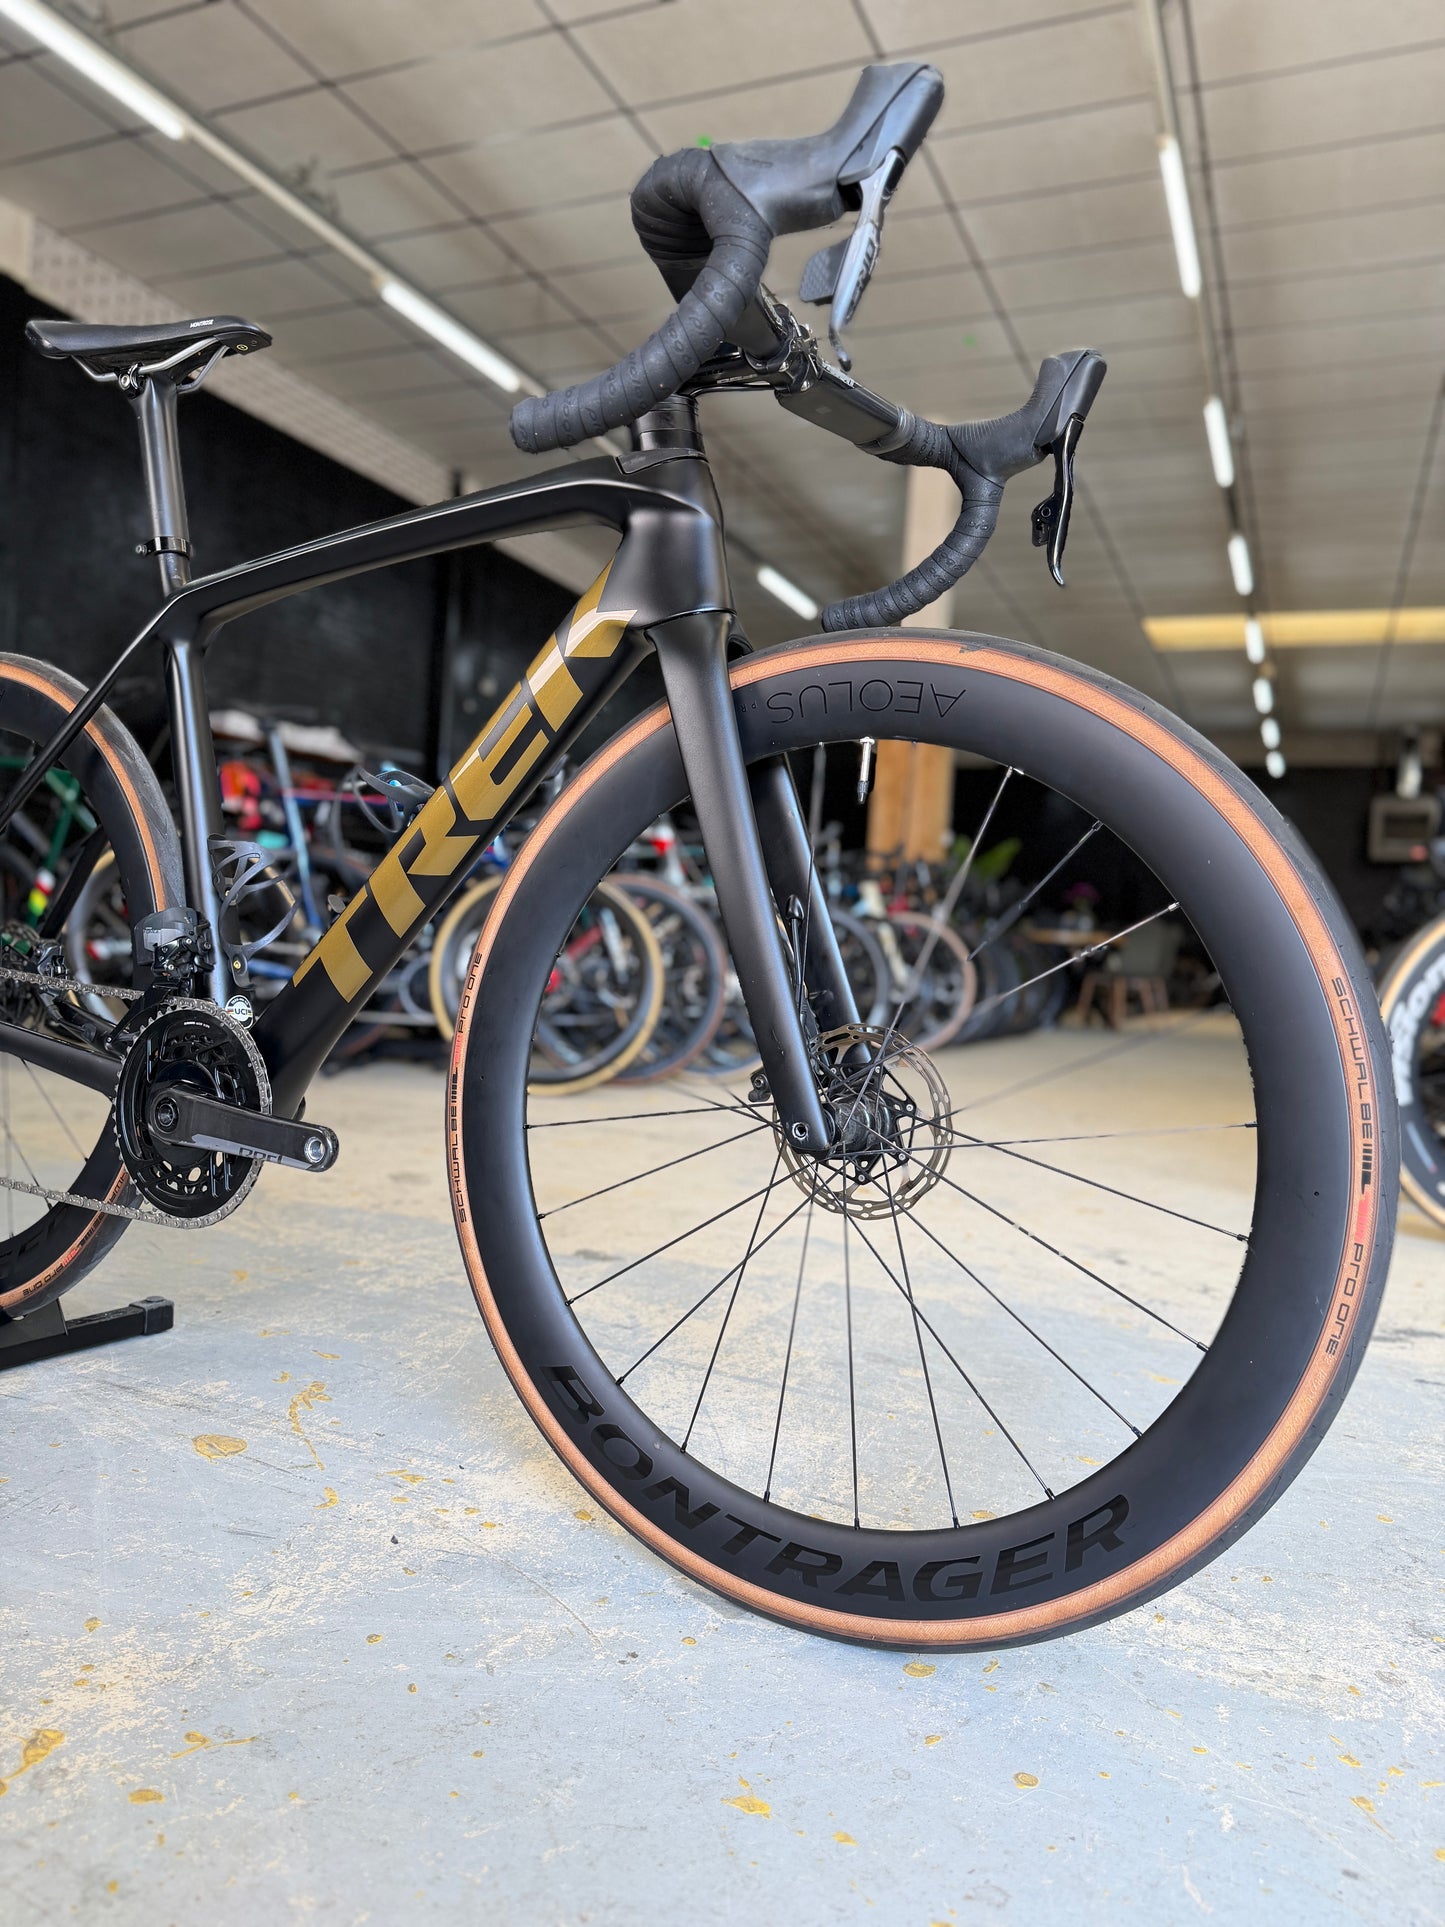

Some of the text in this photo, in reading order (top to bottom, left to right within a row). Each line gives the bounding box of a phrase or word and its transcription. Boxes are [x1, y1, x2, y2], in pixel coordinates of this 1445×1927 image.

[766, 679, 967, 724] AEOLUS
[293, 556, 638, 1003] TREK
[234, 1008, 248, 1016] UCI
[1331, 976, 1373, 1140] SCHWALBE
[450, 1105, 467, 1223] SCHWALBE
[544, 1364, 1131, 1602] BONTRAGER
